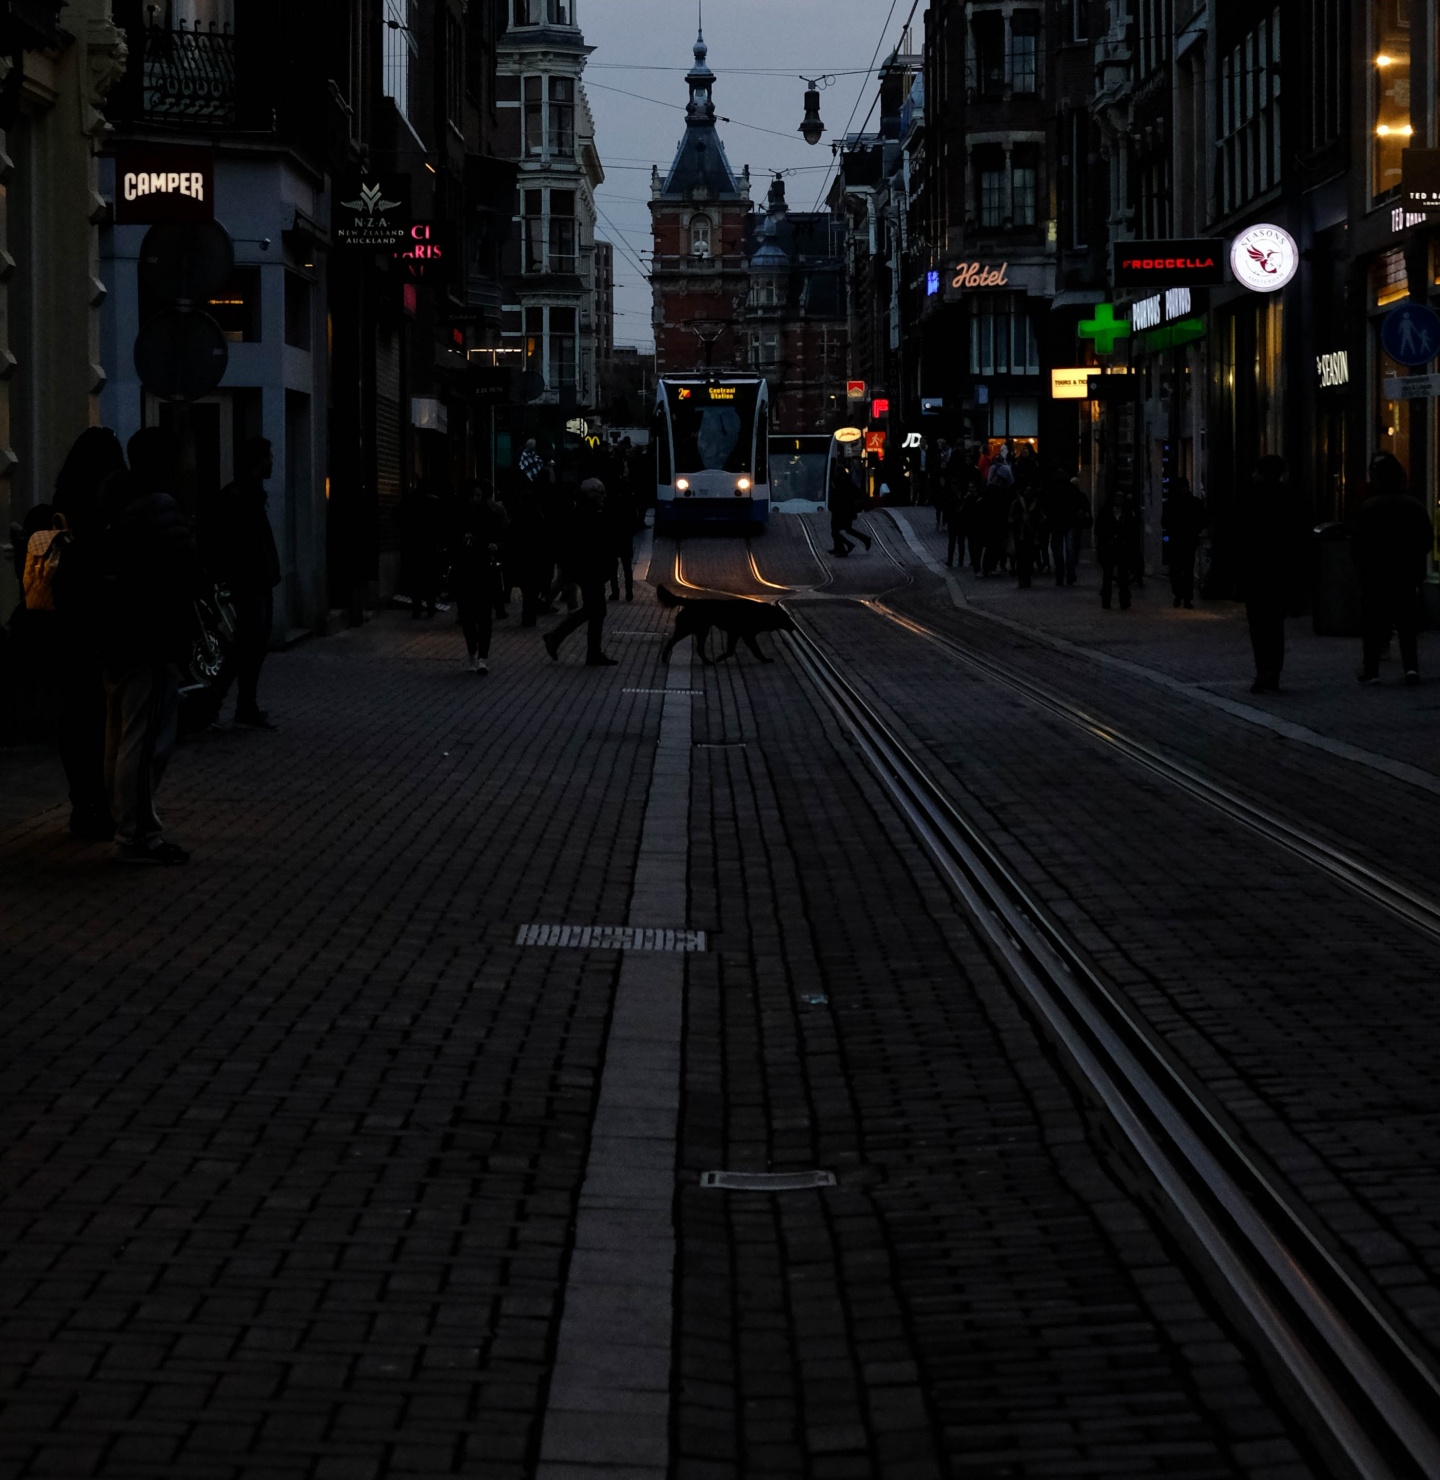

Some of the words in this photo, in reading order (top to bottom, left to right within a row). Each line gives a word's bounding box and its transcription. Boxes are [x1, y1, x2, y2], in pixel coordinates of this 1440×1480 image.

[124, 172, 204, 201] CAMPER
[1409, 192, 1427, 200] TED
[1391, 207, 1404, 233] TED
[1241, 230, 1286, 246] SEASONS
[952, 261, 1009, 288] Hotel
[678, 387, 684, 400] 2
[795, 439, 799, 450] 1
[902, 433, 922, 448] JD
